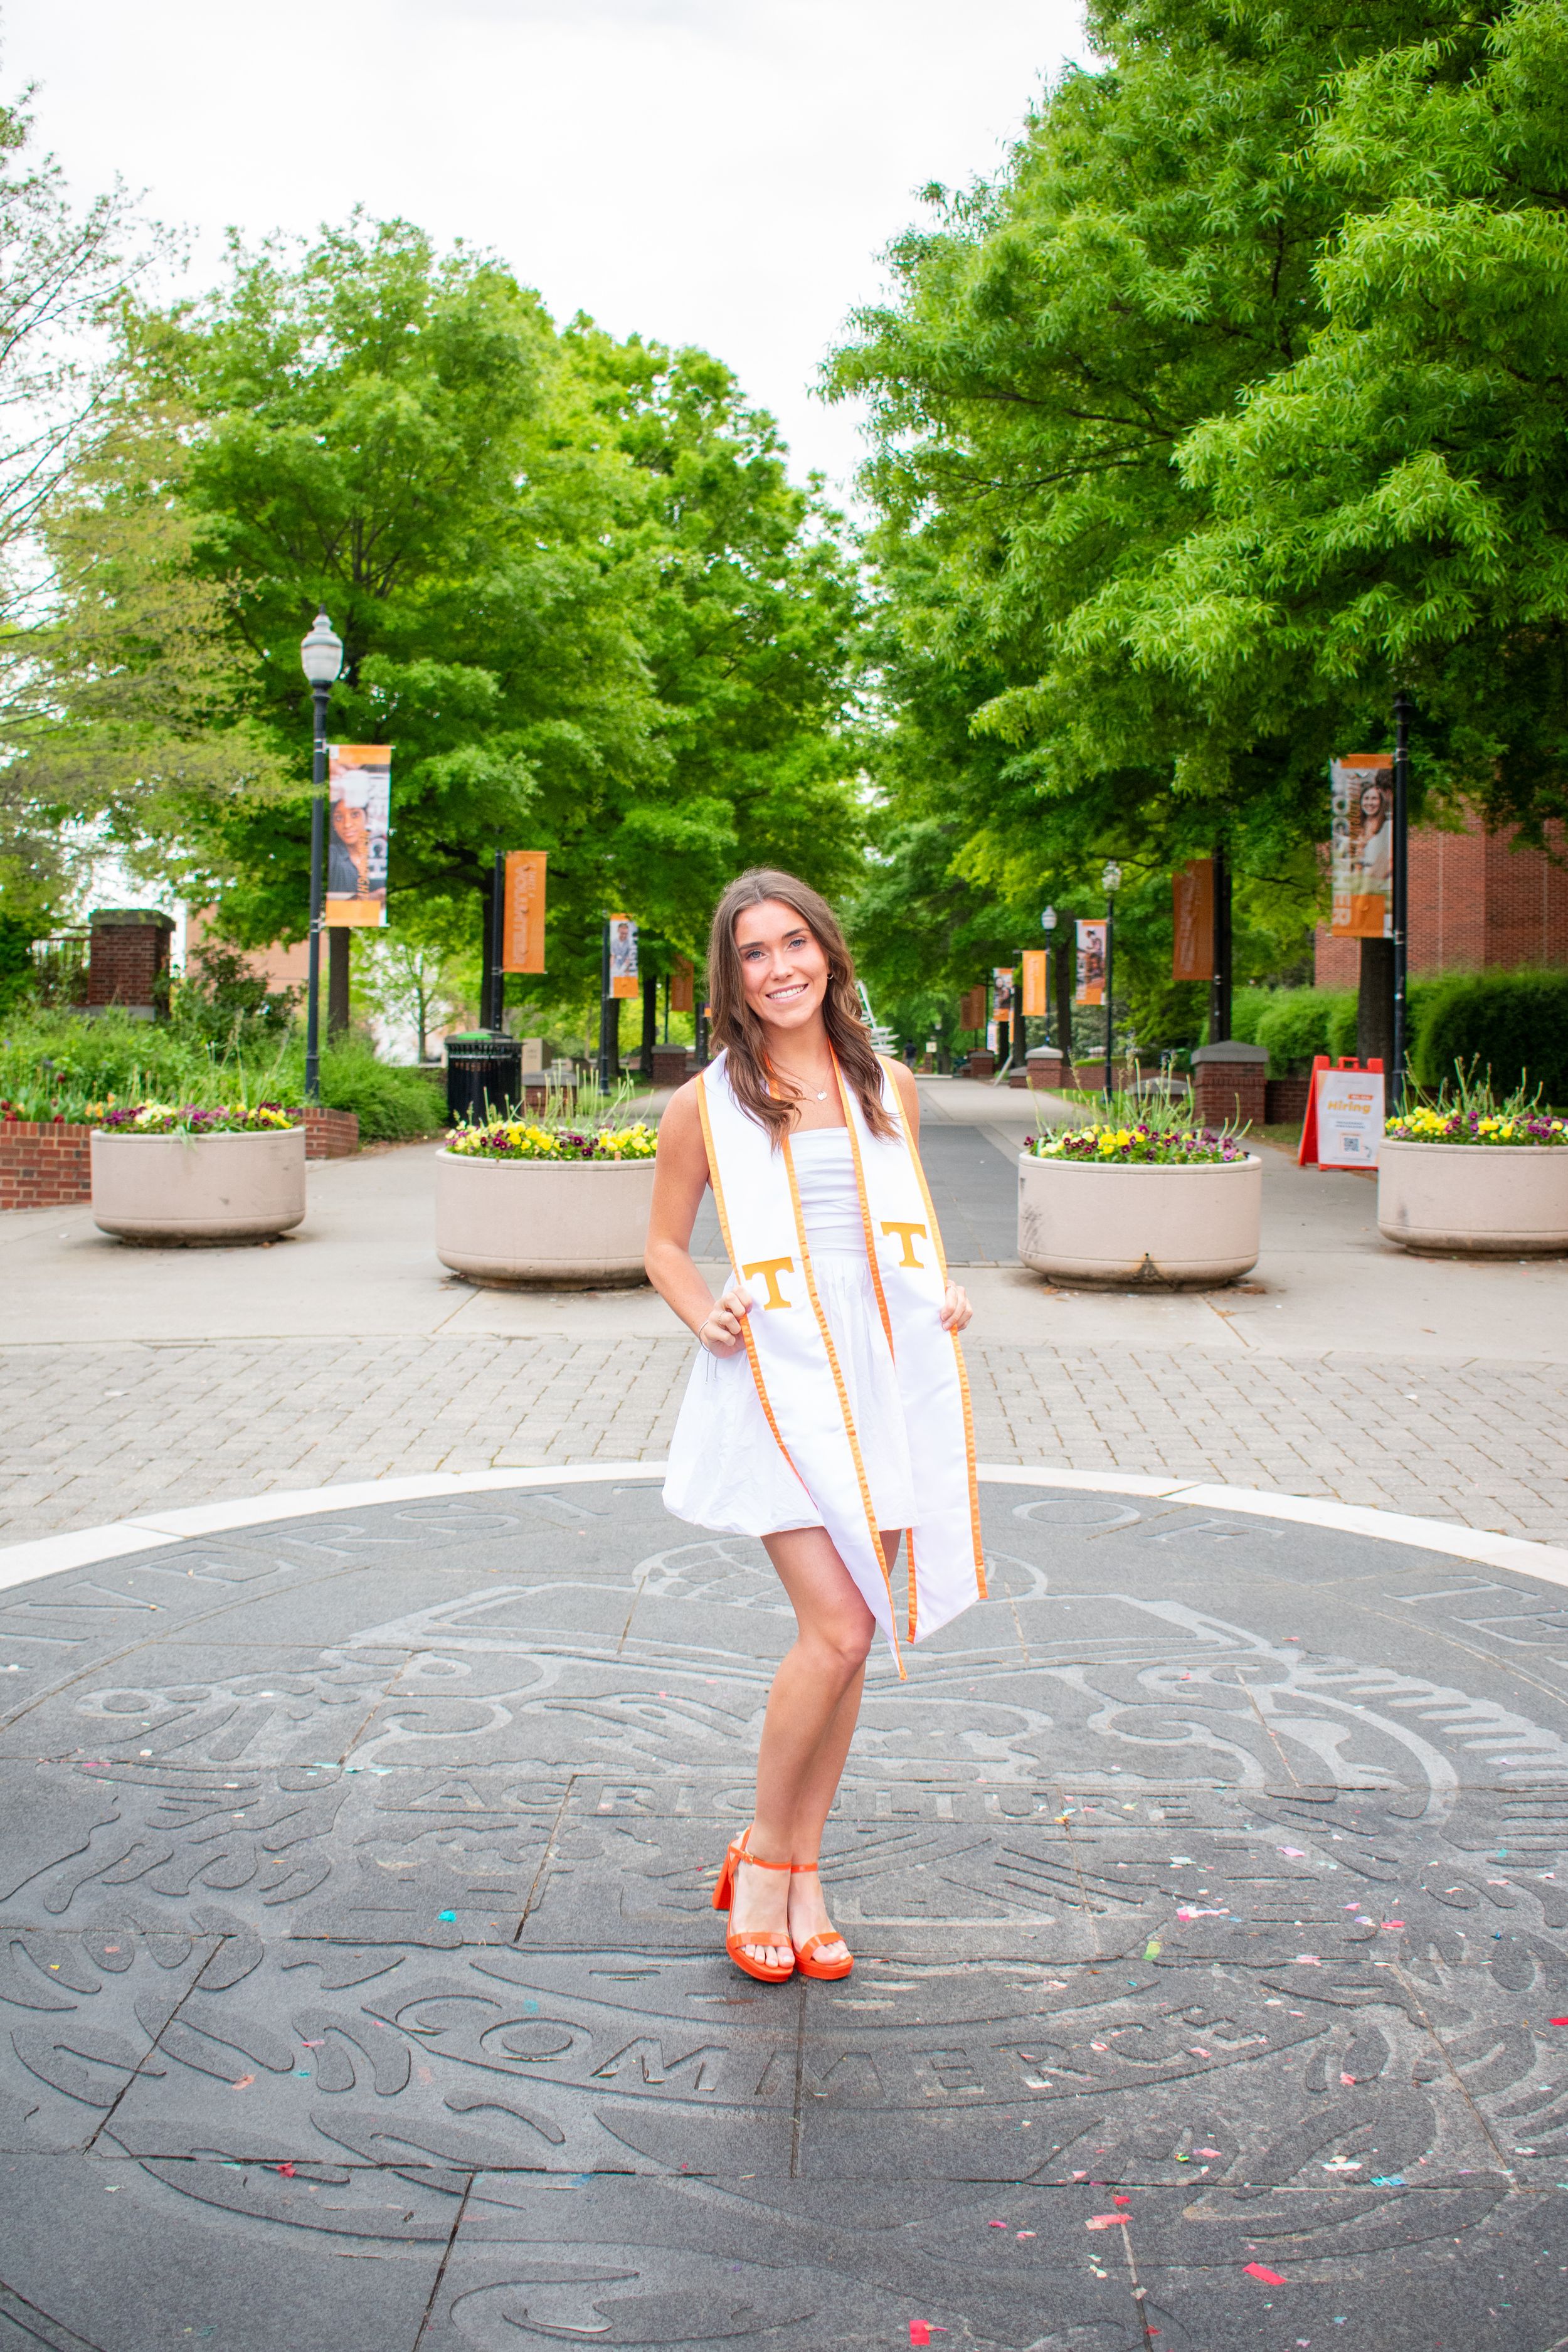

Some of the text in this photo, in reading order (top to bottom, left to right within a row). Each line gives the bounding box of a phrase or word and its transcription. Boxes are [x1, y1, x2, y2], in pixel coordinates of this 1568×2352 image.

[368, 778, 388, 879] REACH
[1332, 780, 1351, 927] TOGETHER
[1327, 1099, 1372, 1115] Hiring
[881, 1221, 928, 1269] T
[742, 1257, 795, 1310] T
[1012, 1498, 1286, 1542] OF
[394, 1993, 1269, 2097] COMMERCE
